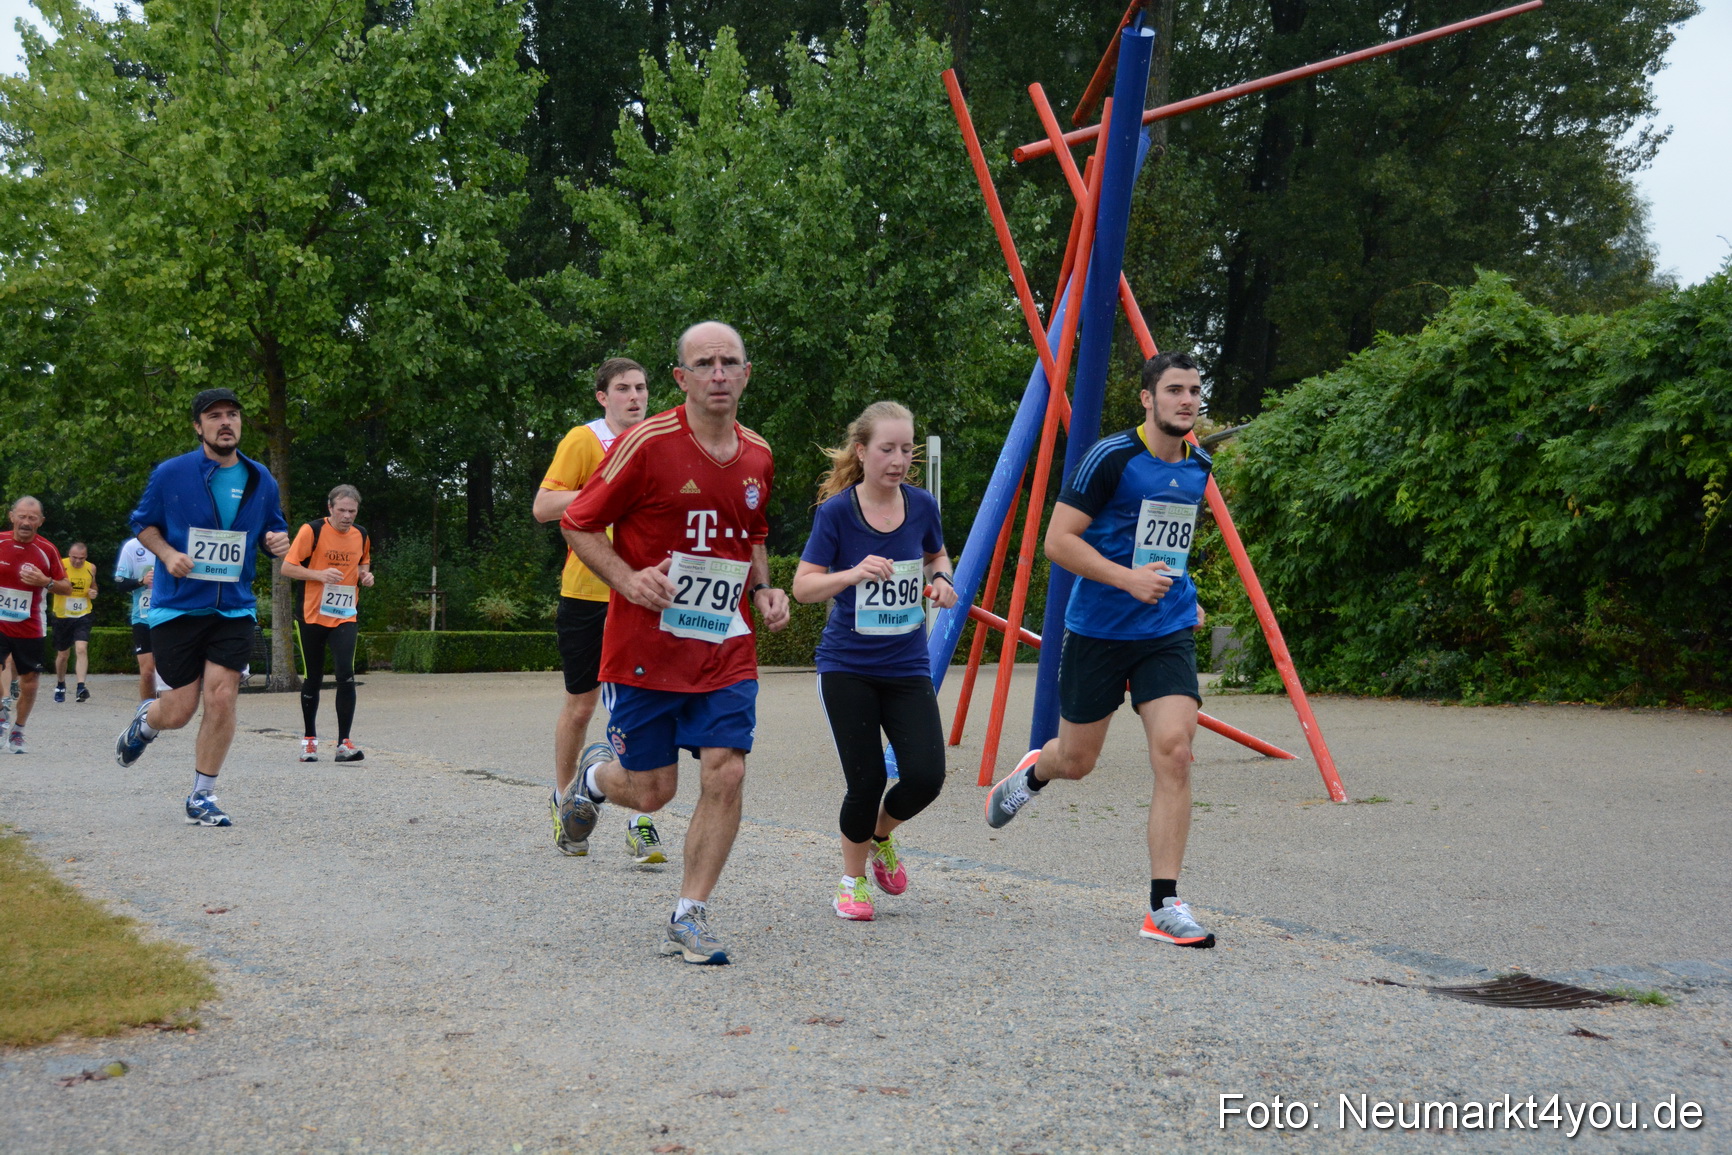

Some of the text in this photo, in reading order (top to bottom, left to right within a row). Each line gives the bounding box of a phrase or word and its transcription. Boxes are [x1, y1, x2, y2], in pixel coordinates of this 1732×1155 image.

[1143, 519, 1192, 549] 2788
[194, 541, 241, 563] 2706
[205, 566, 228, 575] Bernd
[326, 592, 354, 608] 2771
[673, 575, 743, 613] 2798
[865, 577, 919, 607] 2696
[73, 602, 83, 611] 94
[678, 613, 730, 633] Karlheinz
